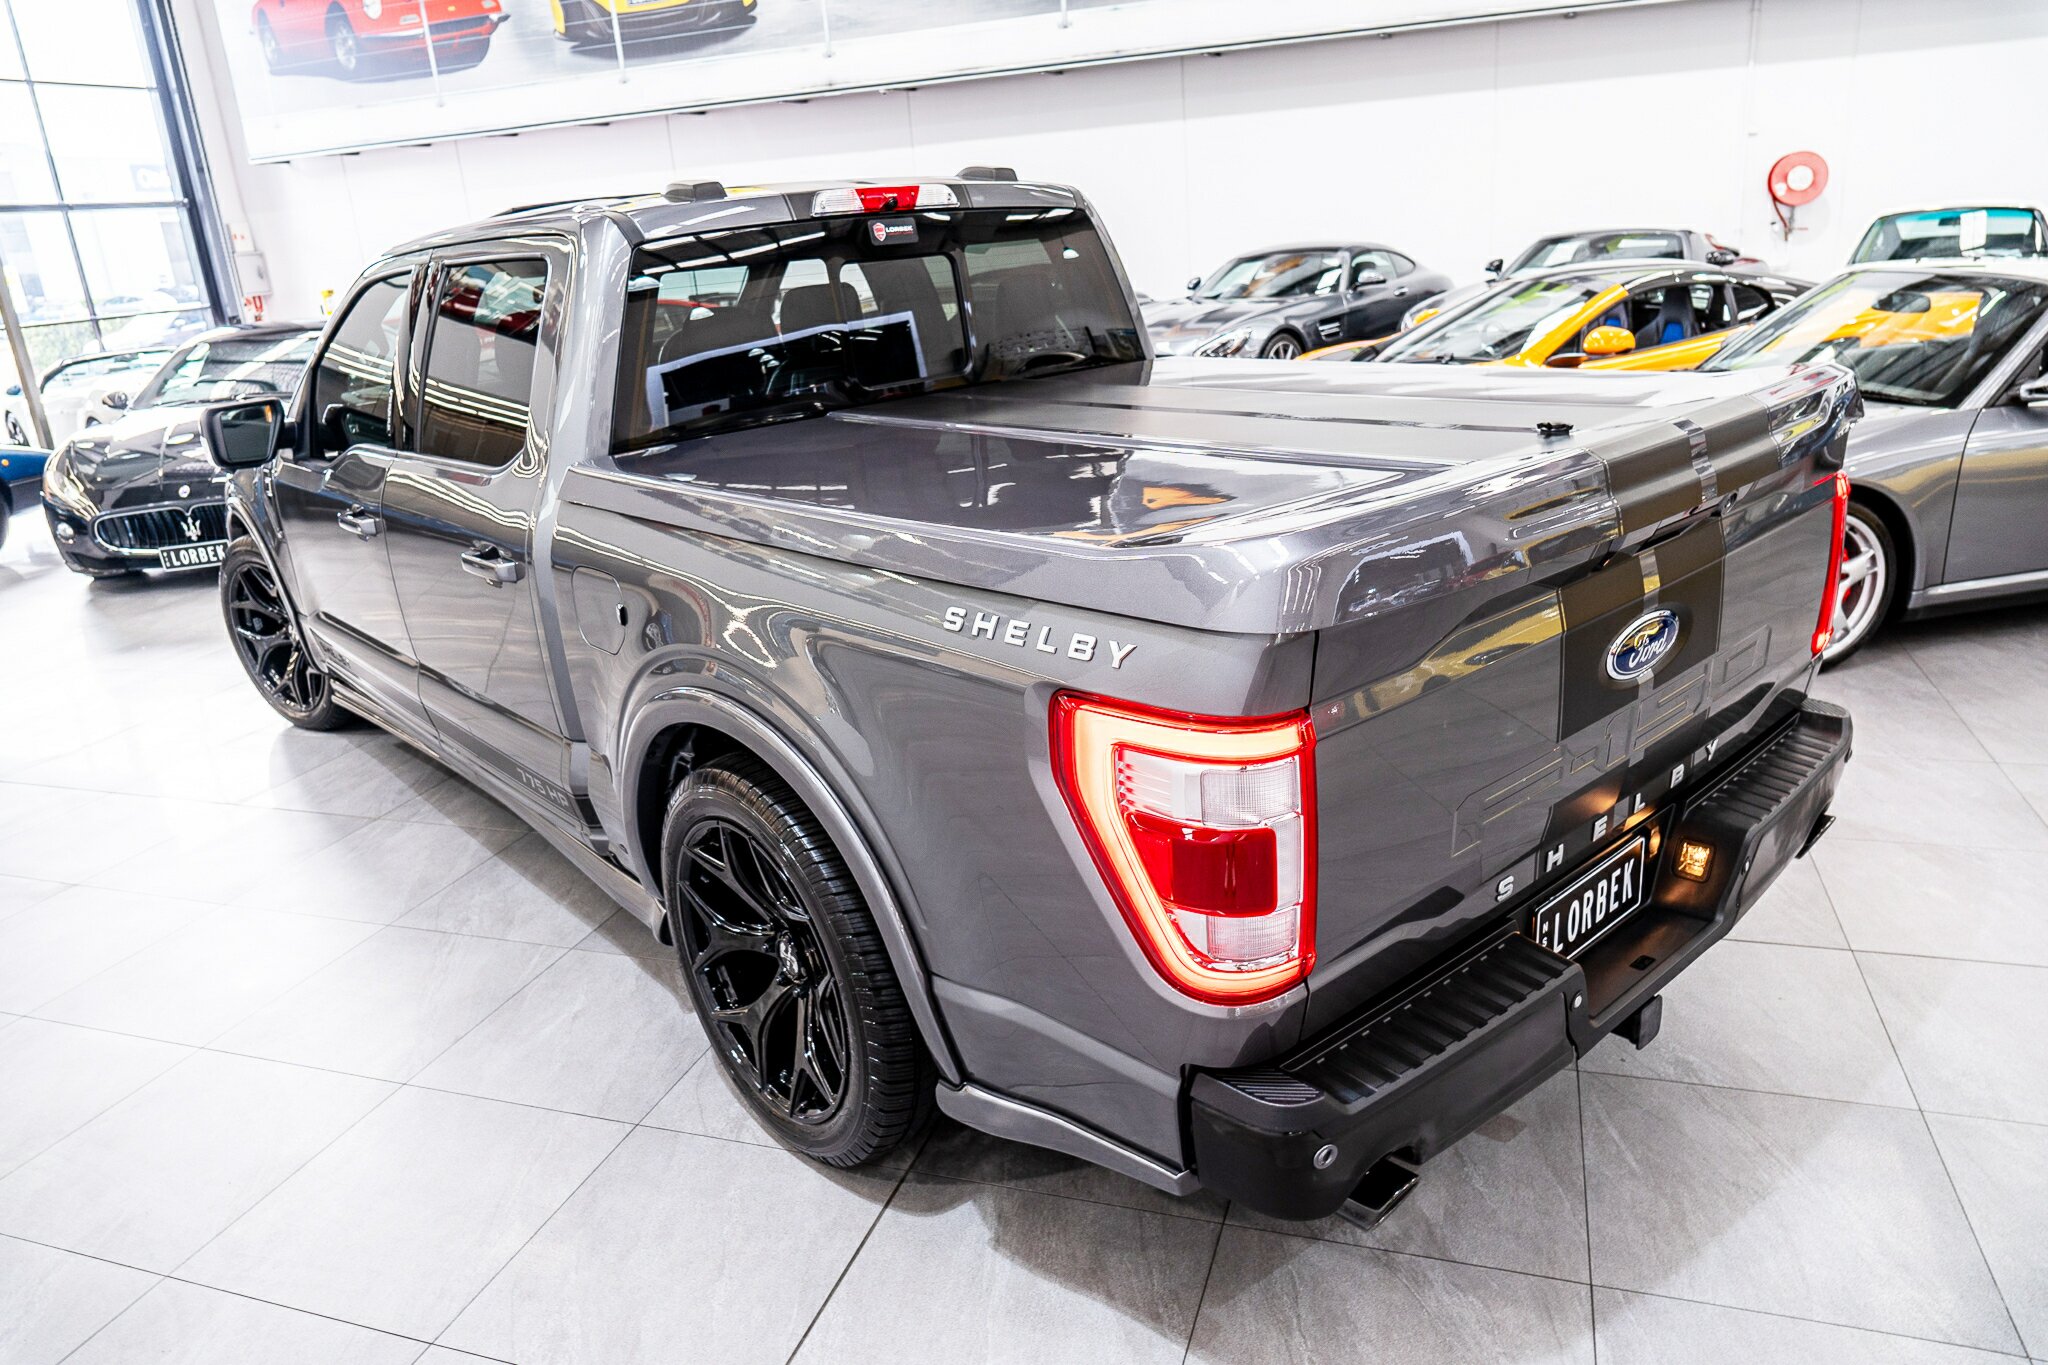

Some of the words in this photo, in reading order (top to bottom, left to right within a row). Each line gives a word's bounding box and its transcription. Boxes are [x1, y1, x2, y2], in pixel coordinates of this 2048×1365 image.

[169, 544, 226, 567] LORBEK
[943, 606, 1138, 669] SHELBY
[1628, 623, 1669, 669] Ford
[516, 767, 546, 796] 775
[1496, 738, 1720, 902] SHELBY
[1552, 857, 1635, 955] LORBEK
[1541, 920, 1550, 948] NS
